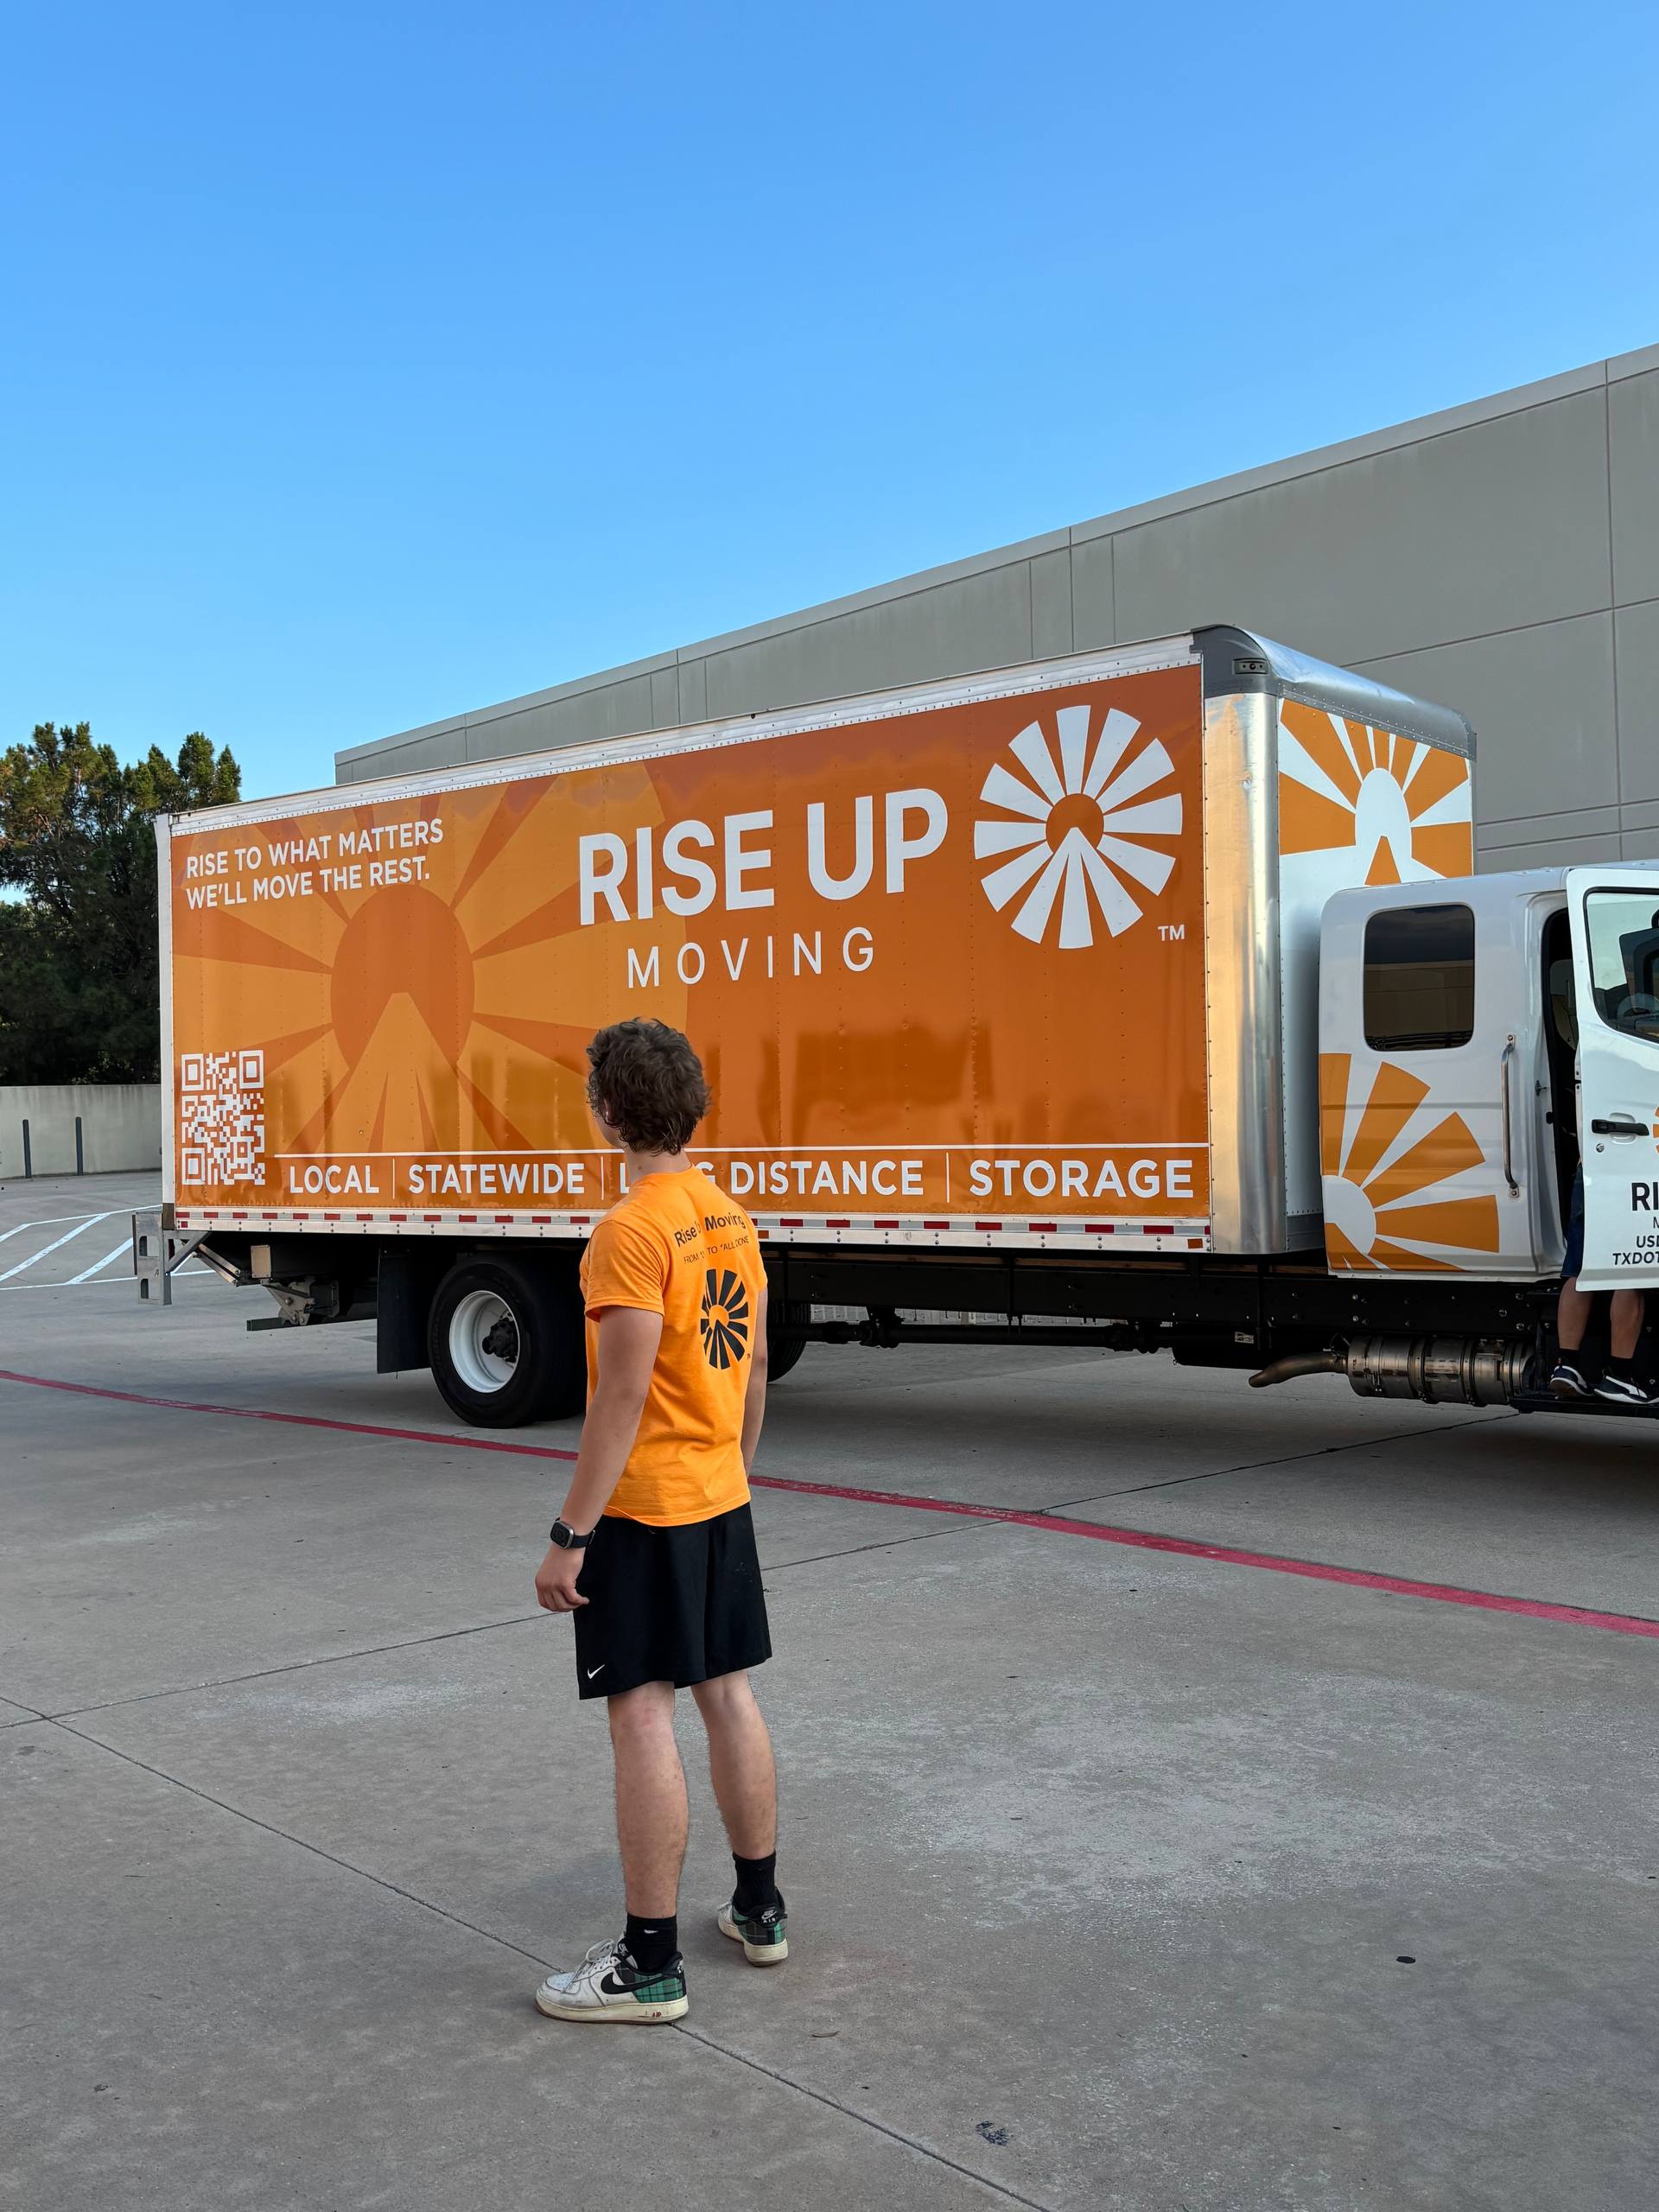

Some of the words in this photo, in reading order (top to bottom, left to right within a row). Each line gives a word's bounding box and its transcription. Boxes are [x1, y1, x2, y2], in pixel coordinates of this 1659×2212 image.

[187, 851, 228, 879] RISE
[234, 846, 262, 871] TO
[268, 835, 332, 867] WHAT
[339, 817, 443, 857] MATTERS
[580, 810, 775, 925] RISE
[807, 788, 948, 900] UP
[186, 881, 247, 910] WE'LL
[253, 872, 313, 901] MOVE
[319, 864, 362, 893] THE
[371, 855, 430, 887] REST.
[1158, 925, 1185, 941] TM
[627, 926, 874, 988] MOVING
[289, 1165, 379, 1194] LOCAL
[409, 1163, 585, 1194] STATEWIDE
[730, 1160, 924, 1195] DISTANCE
[969, 1160, 1193, 1198] STORAGE
[673, 1226, 697, 1248] Rise
[704, 1212, 747, 1231] Moving
[707, 1245, 718, 1255] TO
